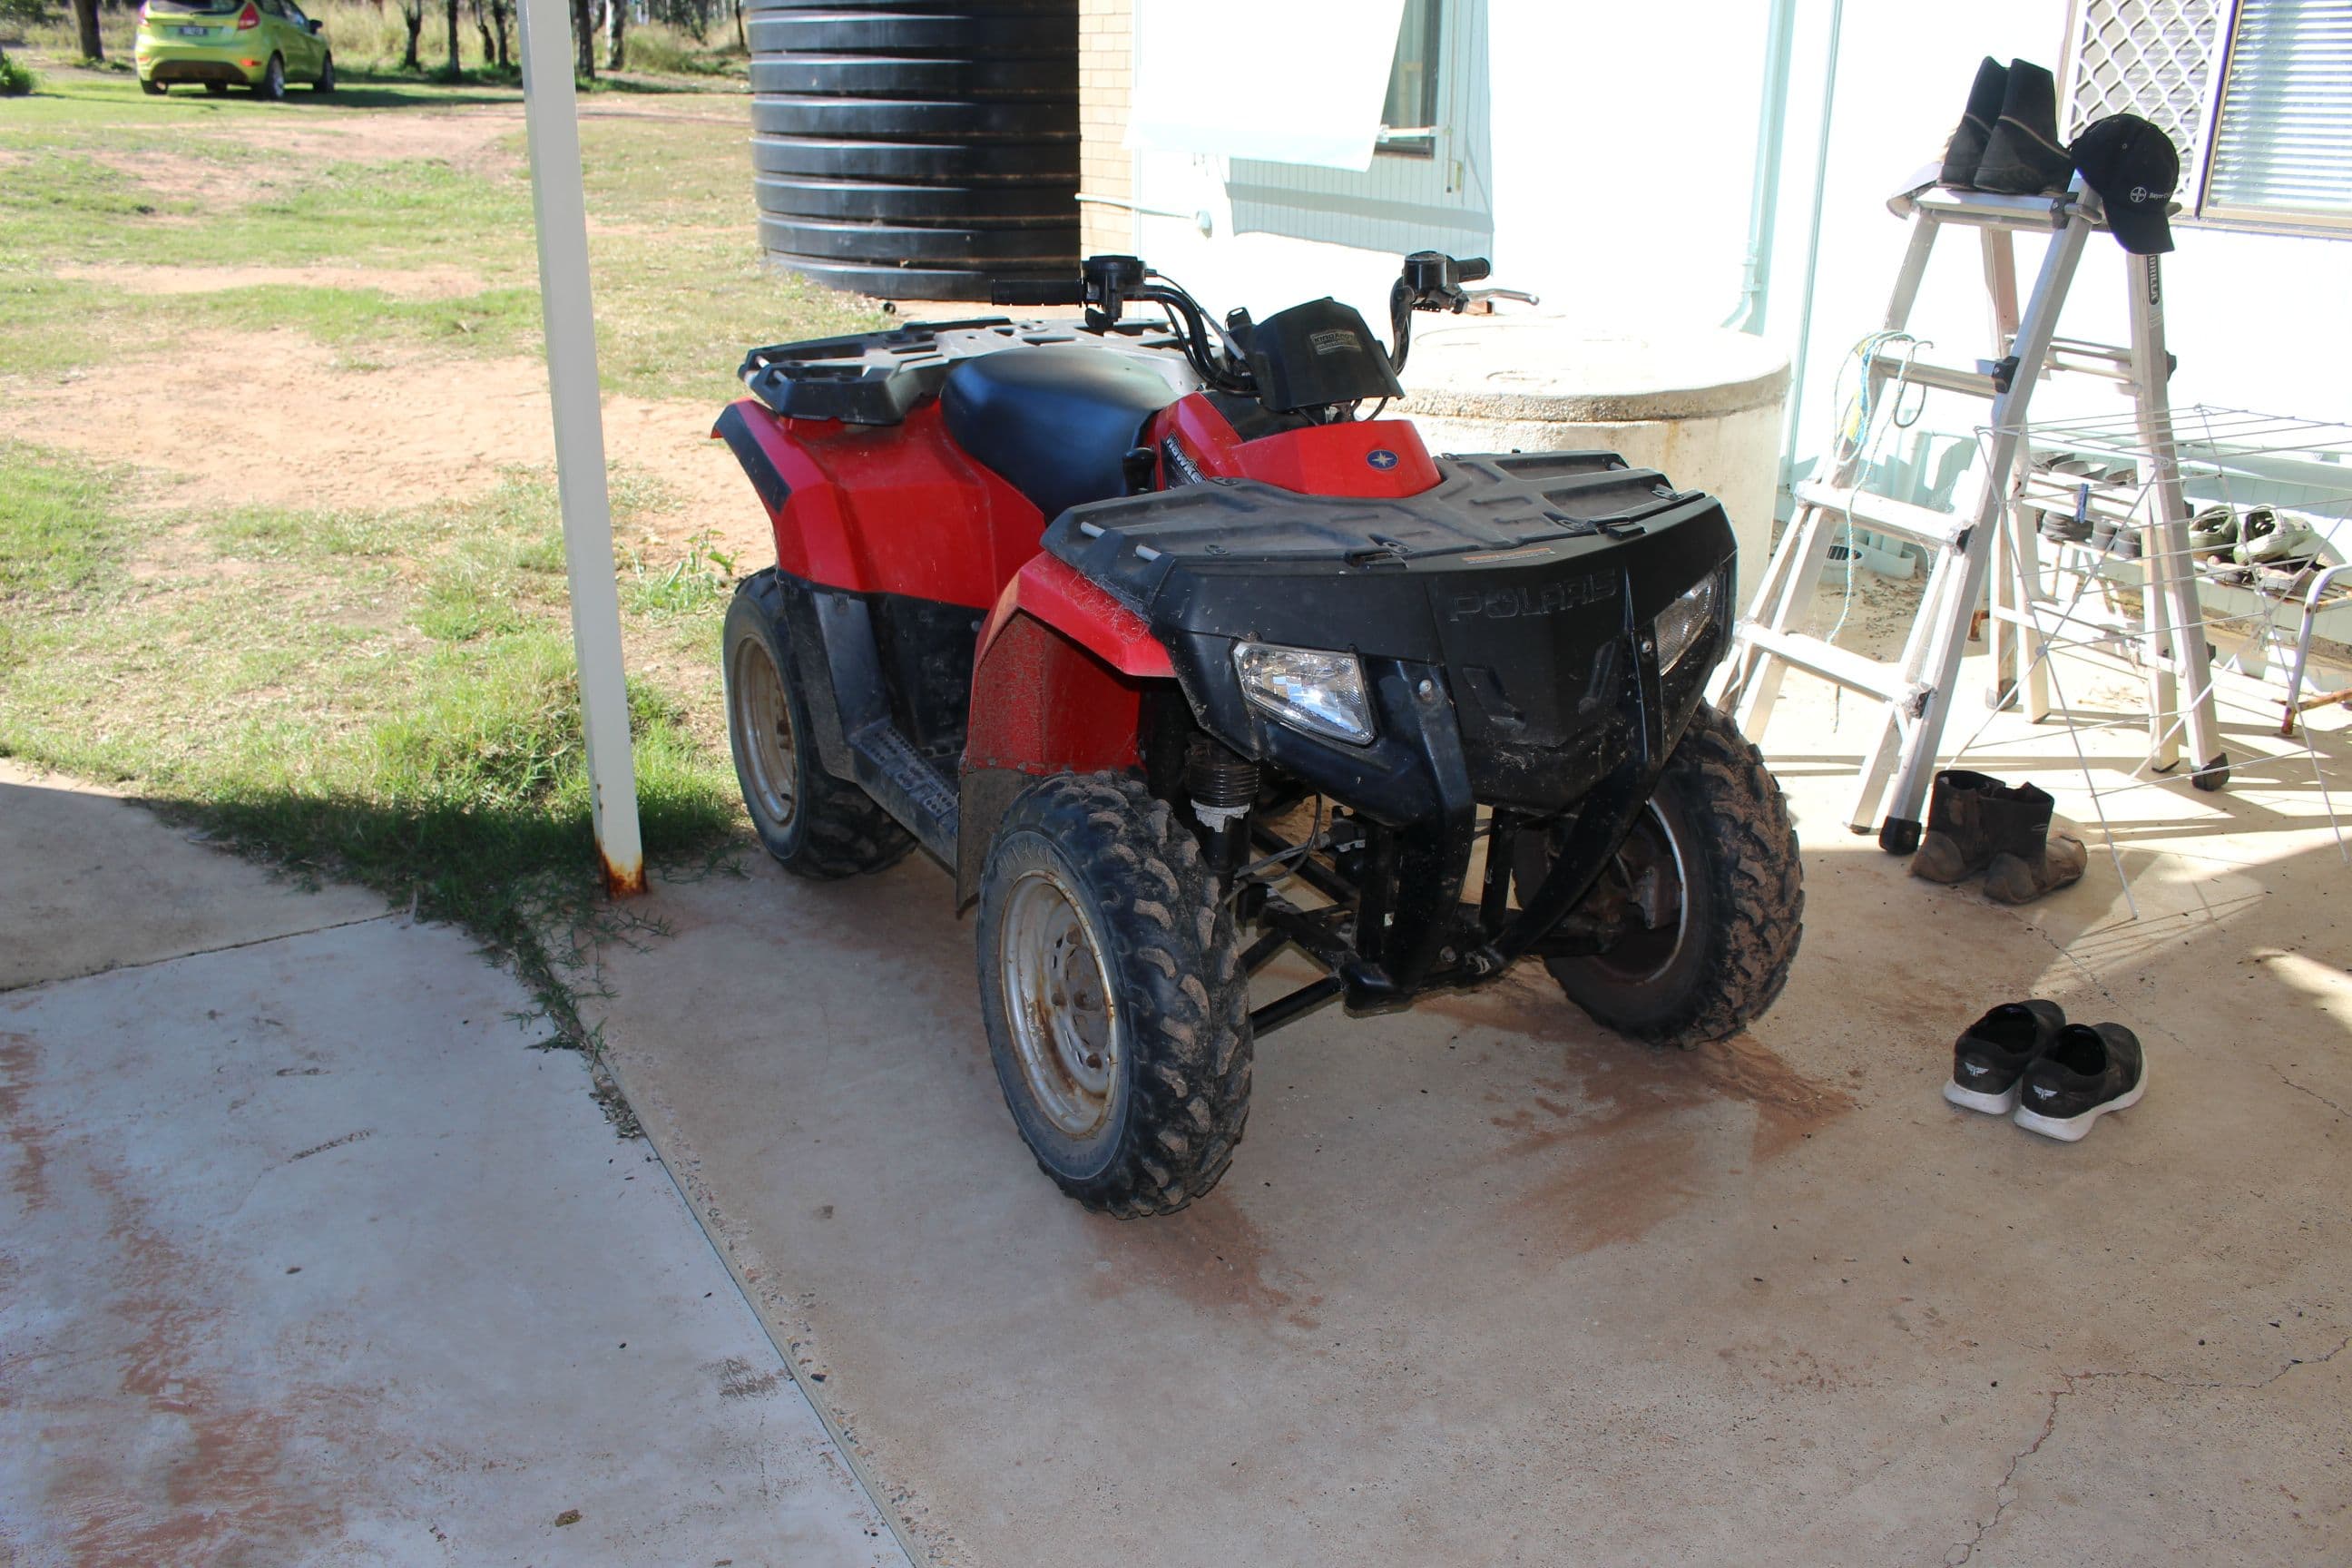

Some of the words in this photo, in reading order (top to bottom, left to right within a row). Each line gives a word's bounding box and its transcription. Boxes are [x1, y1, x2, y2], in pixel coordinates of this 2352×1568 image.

[2149, 254, 2158, 299] ORILLA
[1166, 434, 1204, 485] Hawke
[1449, 568, 1617, 622] POLARIS
